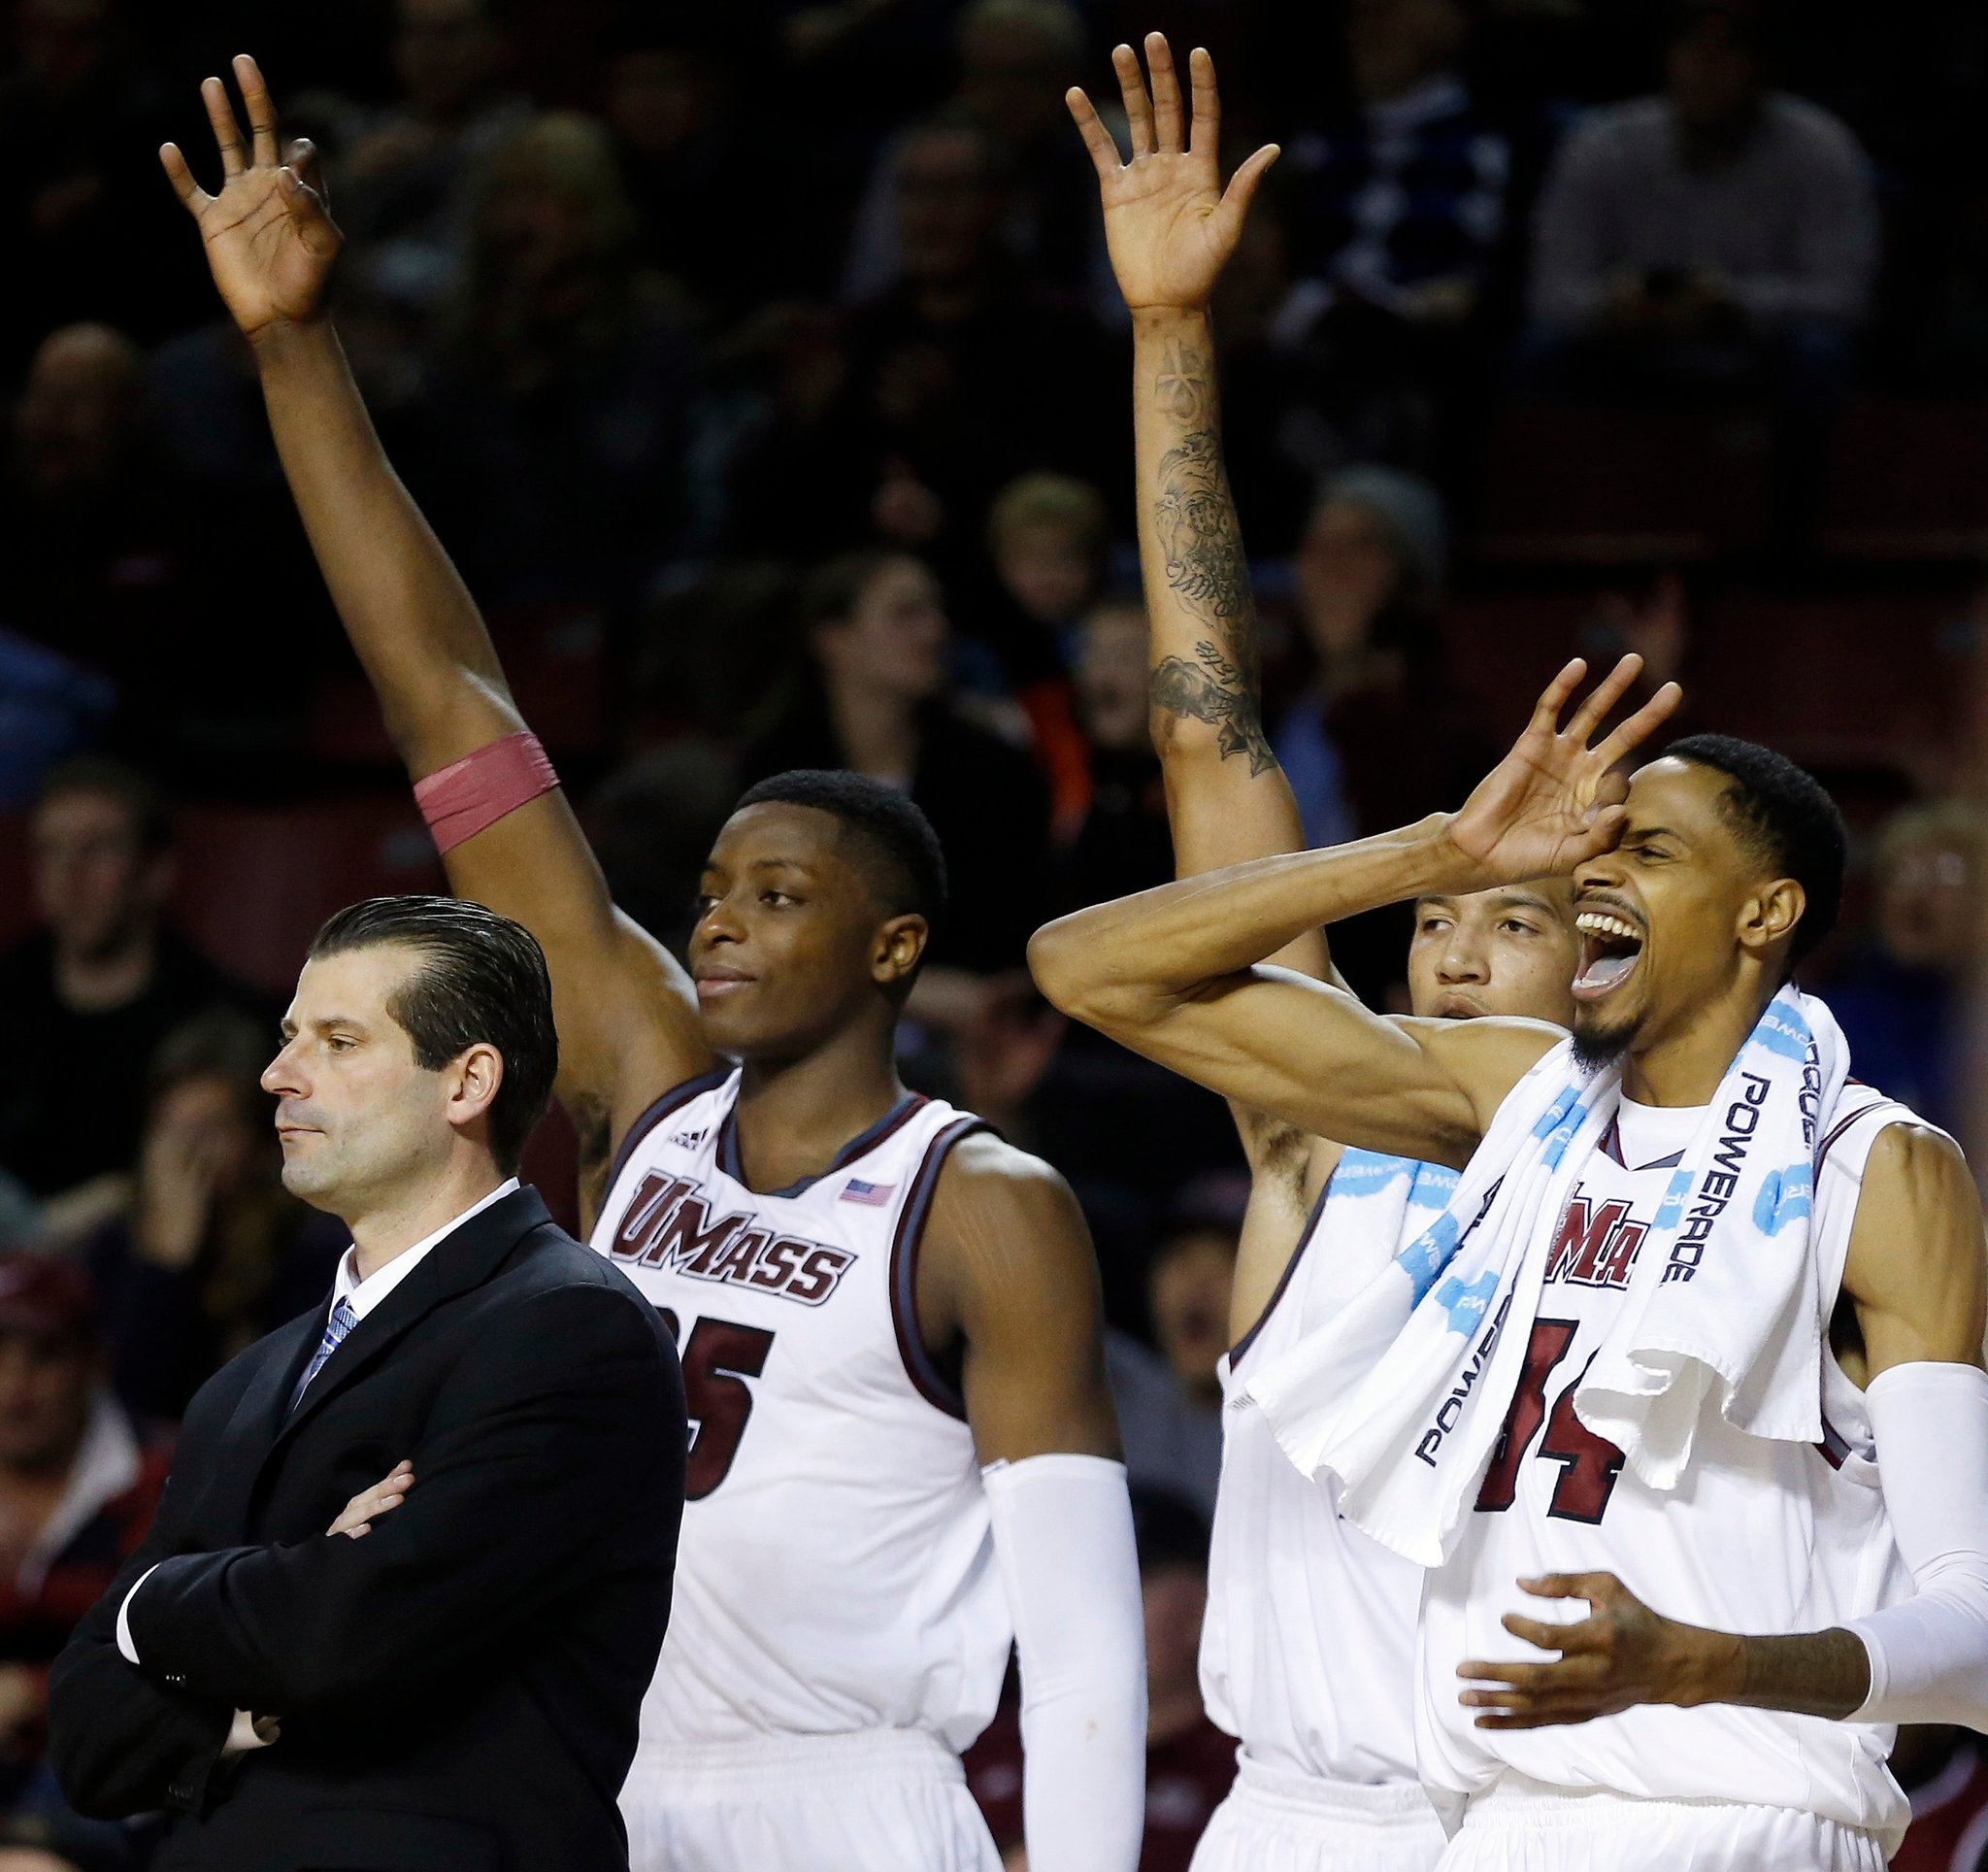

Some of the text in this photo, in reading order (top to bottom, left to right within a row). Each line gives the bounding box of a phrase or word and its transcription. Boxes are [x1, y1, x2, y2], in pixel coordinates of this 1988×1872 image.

[610, 1167, 859, 1307] UMASS
[1659, 1071, 1772, 1285] POWERADE
[656, 1307, 776, 1501] 5
